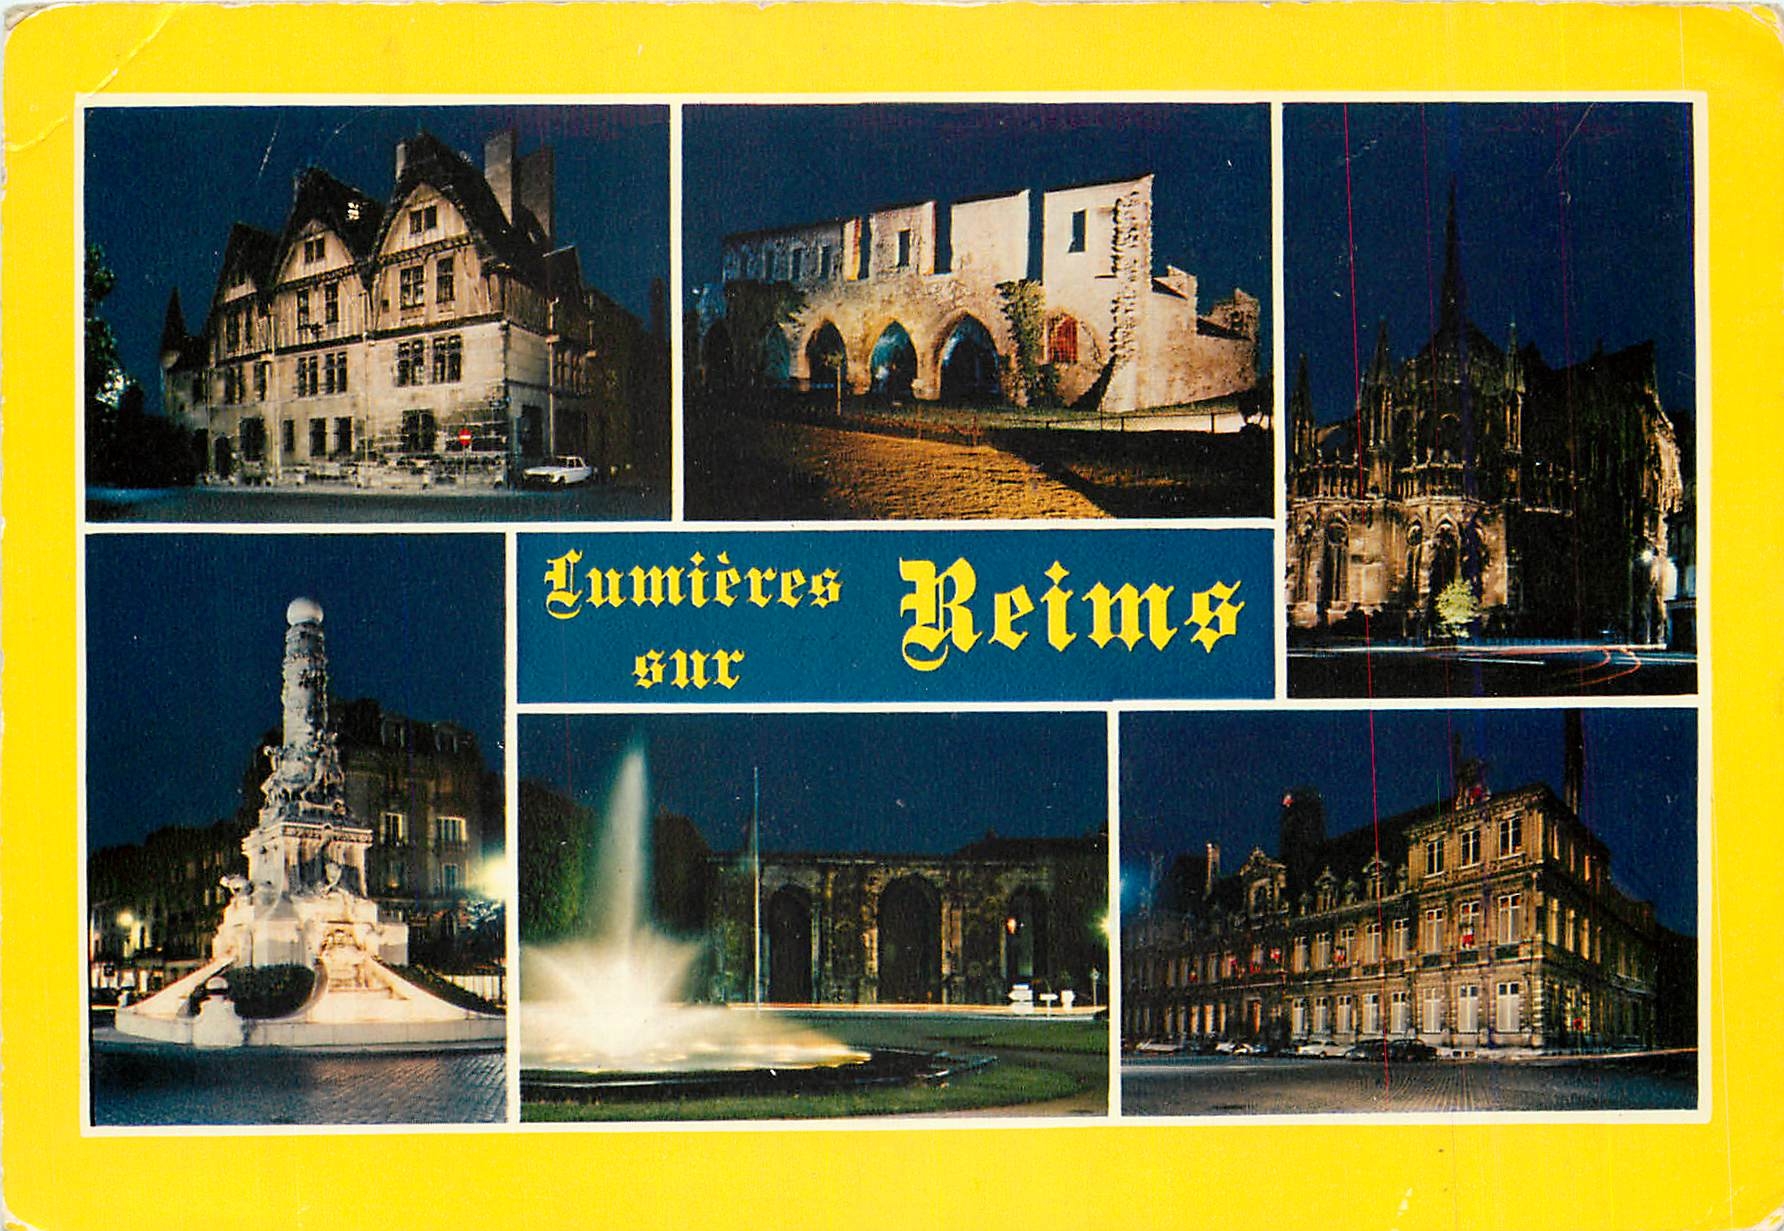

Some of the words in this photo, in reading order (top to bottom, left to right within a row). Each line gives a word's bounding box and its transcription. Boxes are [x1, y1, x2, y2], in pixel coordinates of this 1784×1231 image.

[545, 549, 842, 620] Lumières
[900, 557, 1245, 672] Reims
[632, 648, 745, 689] sur
